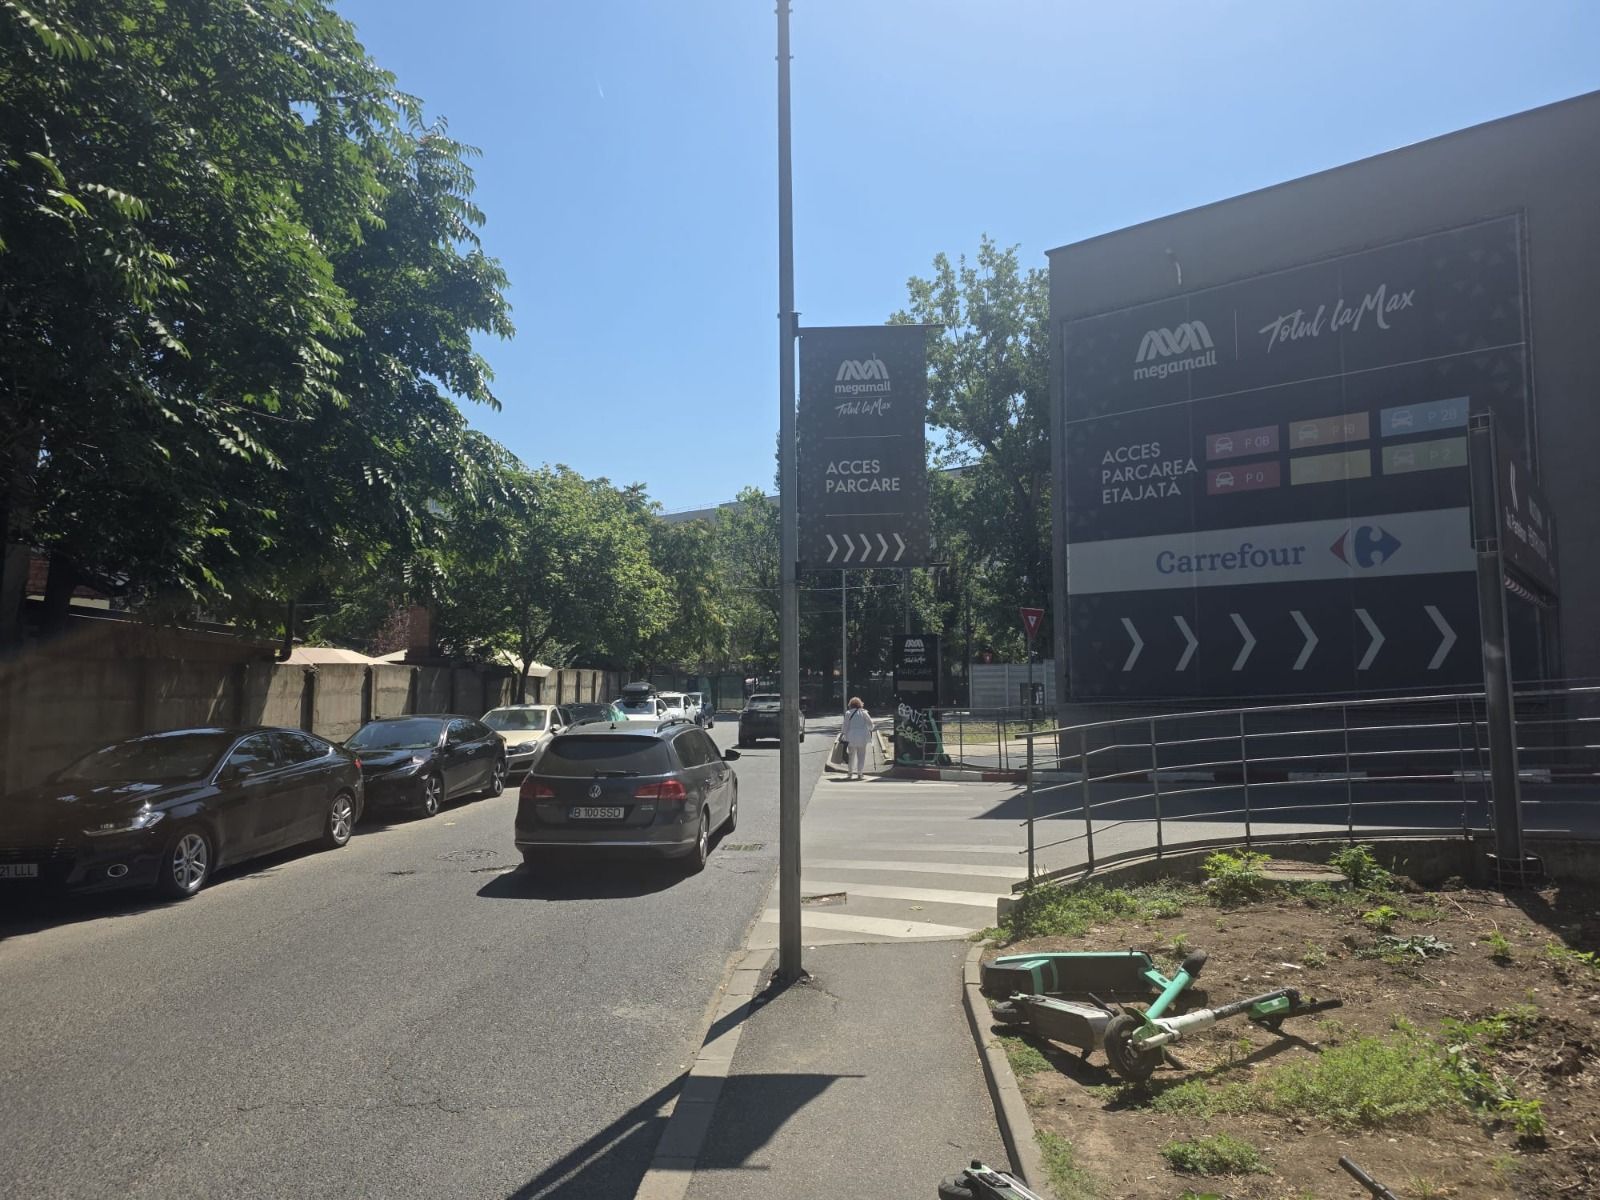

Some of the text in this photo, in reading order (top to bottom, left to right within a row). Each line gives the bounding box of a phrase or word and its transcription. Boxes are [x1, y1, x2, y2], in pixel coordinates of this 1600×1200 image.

[1133, 349, 1217, 381] megamall
[834, 380, 891, 395] megamall
[1102, 442, 1160, 465] ACCES
[826, 459, 880, 475] ACCES
[1102, 458, 1199, 485] PARCAREA
[826, 477, 901, 493] PARCARE
[1102, 476, 1181, 504] ETAJATĂ
[1156, 542, 1306, 575] Carrefour
[573, 807, 581, 818] B
[584, 807, 598, 818] 100
